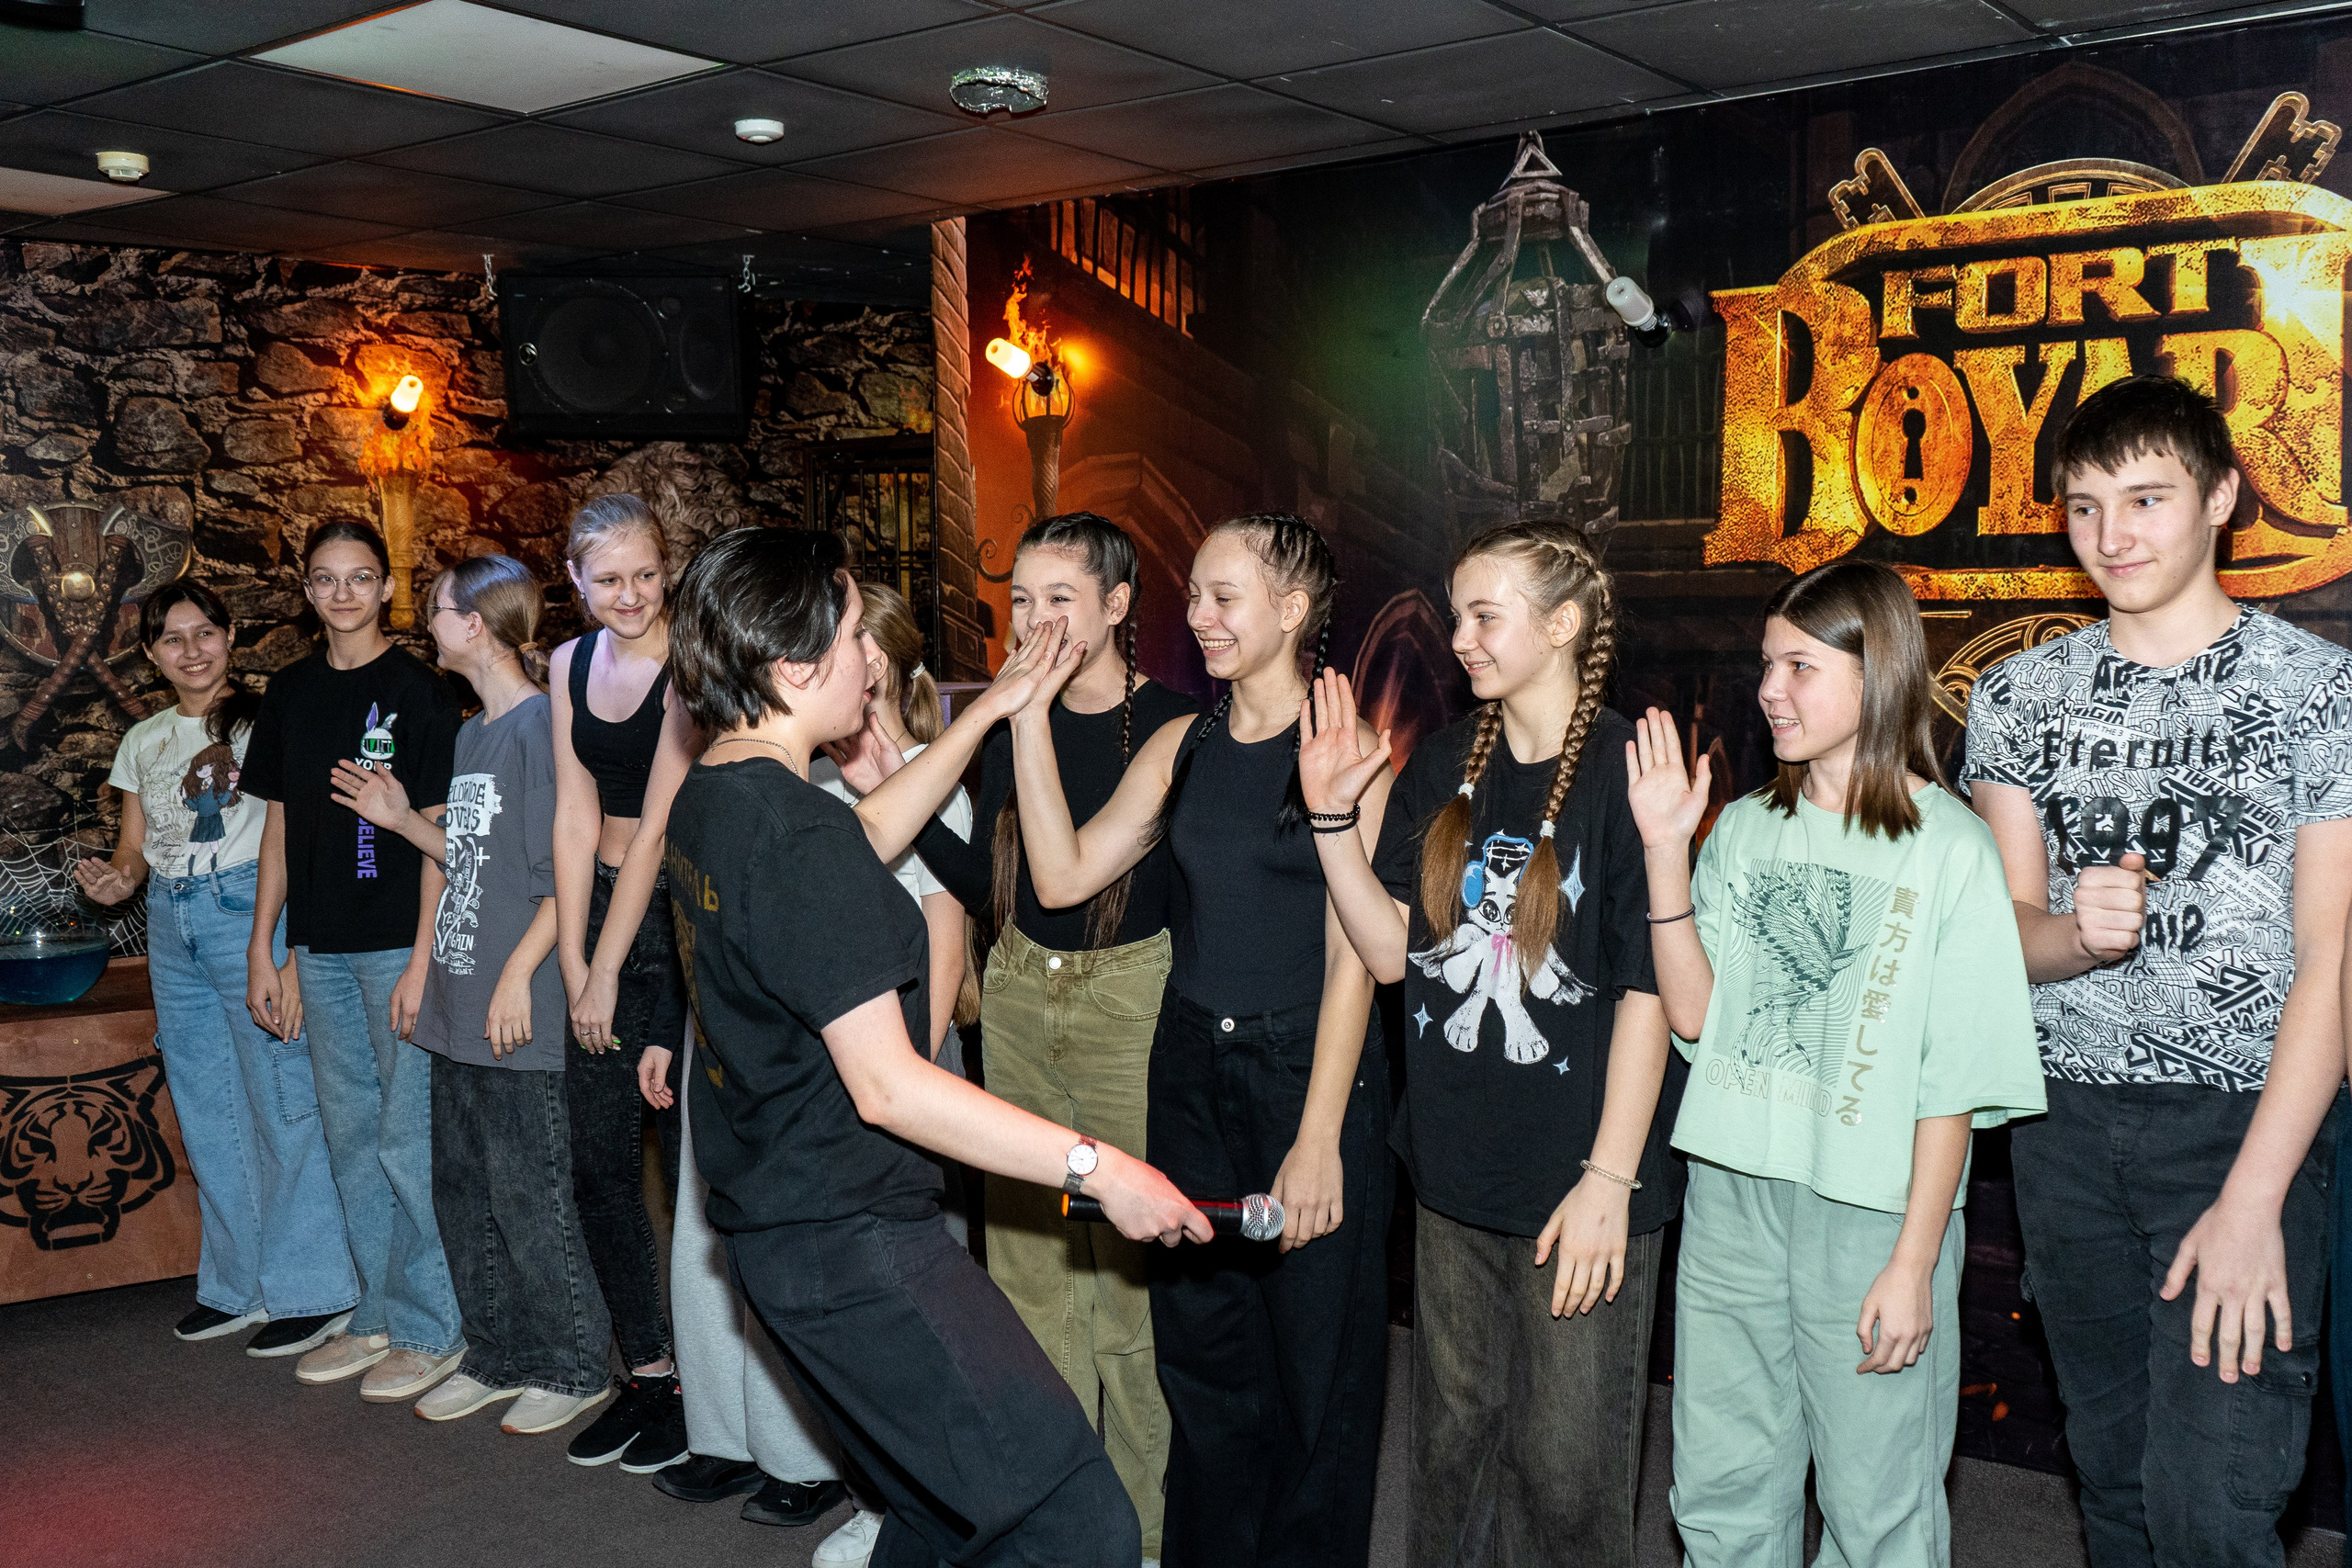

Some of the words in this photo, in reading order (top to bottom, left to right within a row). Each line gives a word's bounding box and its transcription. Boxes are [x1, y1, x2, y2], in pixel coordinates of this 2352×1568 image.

[1880, 237, 2240, 340] FORT
[2094, 990, 2124, 1010] STRIPES
[1705, 1058, 1772, 1100] OPEN
[1778, 1076, 1833, 1118] MIND
